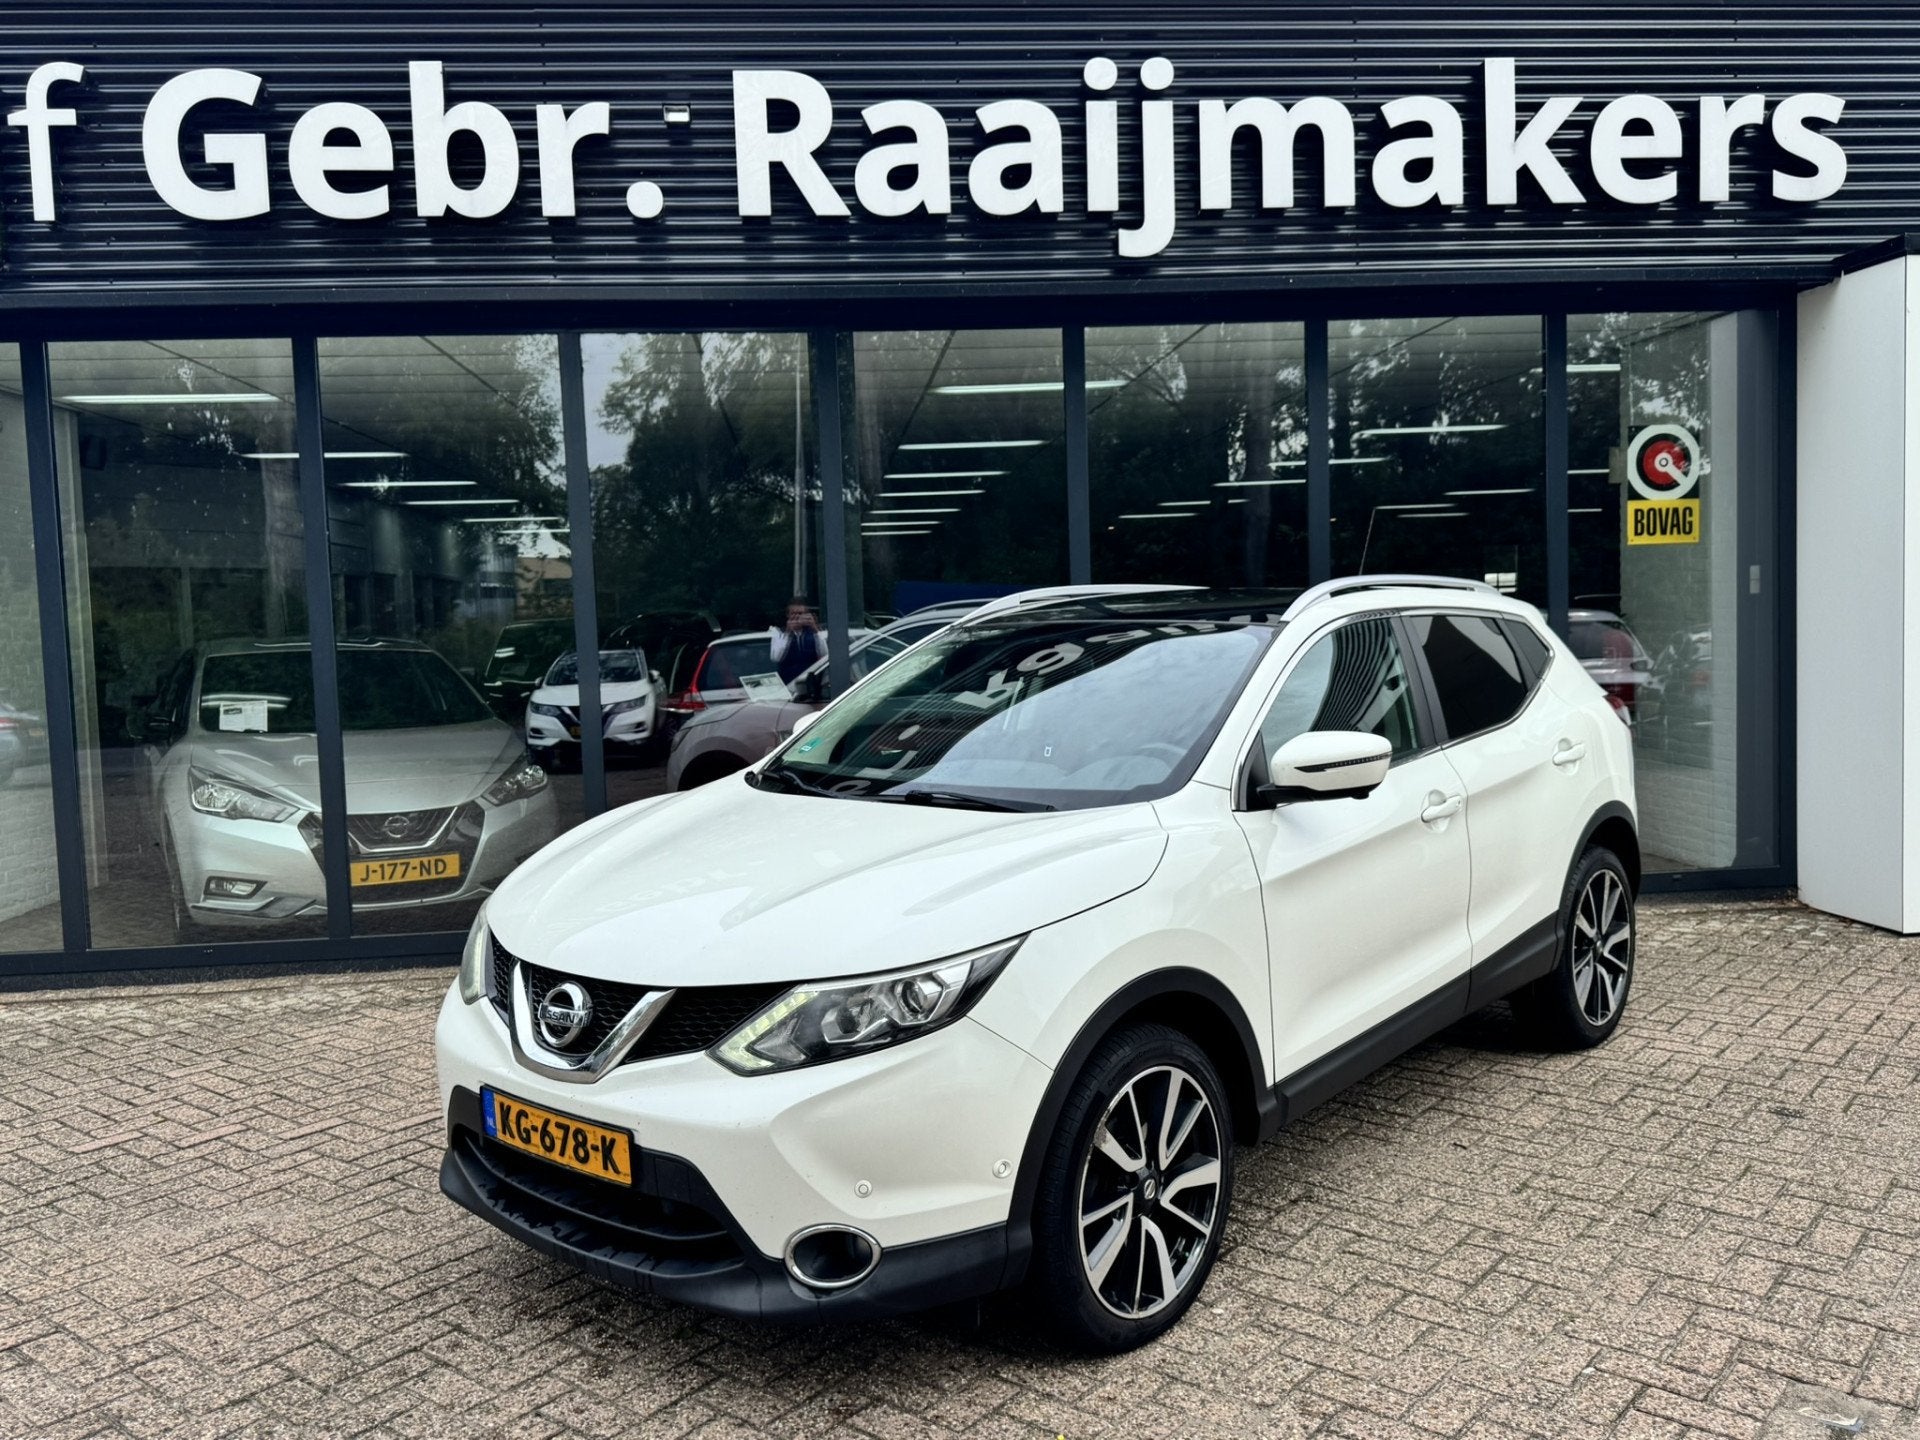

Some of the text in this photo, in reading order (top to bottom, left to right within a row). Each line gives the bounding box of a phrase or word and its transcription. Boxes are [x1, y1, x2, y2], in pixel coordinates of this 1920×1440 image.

[142, 60, 664, 221] Gebr.
[732, 56, 1848, 258] Raaijmakers
[1634, 506, 1693, 536] BOVAG
[360, 858, 447, 882] J-177-ND
[540, 1008, 576, 1024] SSAN
[499, 1101, 621, 1175] KG-678-K
